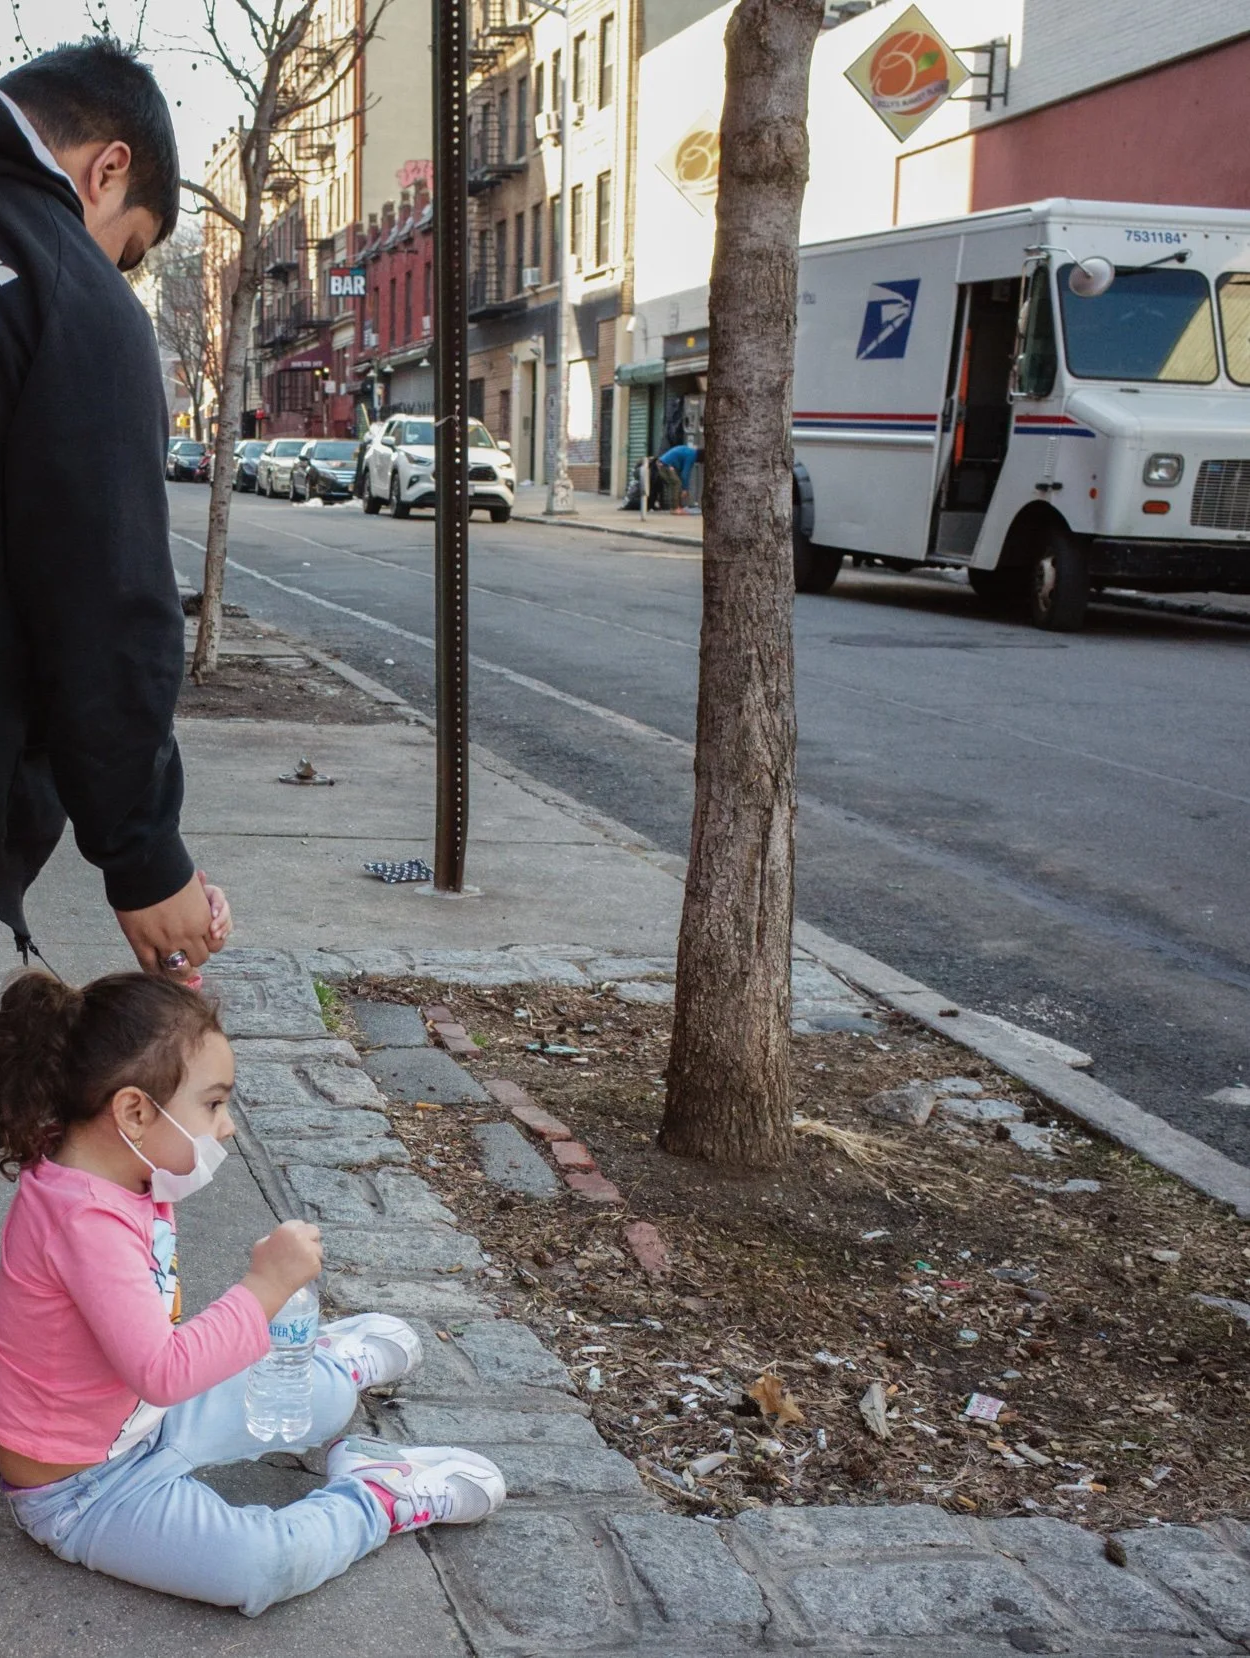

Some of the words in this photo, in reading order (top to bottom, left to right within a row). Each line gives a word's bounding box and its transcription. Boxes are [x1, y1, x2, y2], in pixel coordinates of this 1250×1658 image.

[1124, 229, 1181, 244] 7531184
[330, 275, 366, 295] BAR
[268, 1324, 288, 1338] ATER
